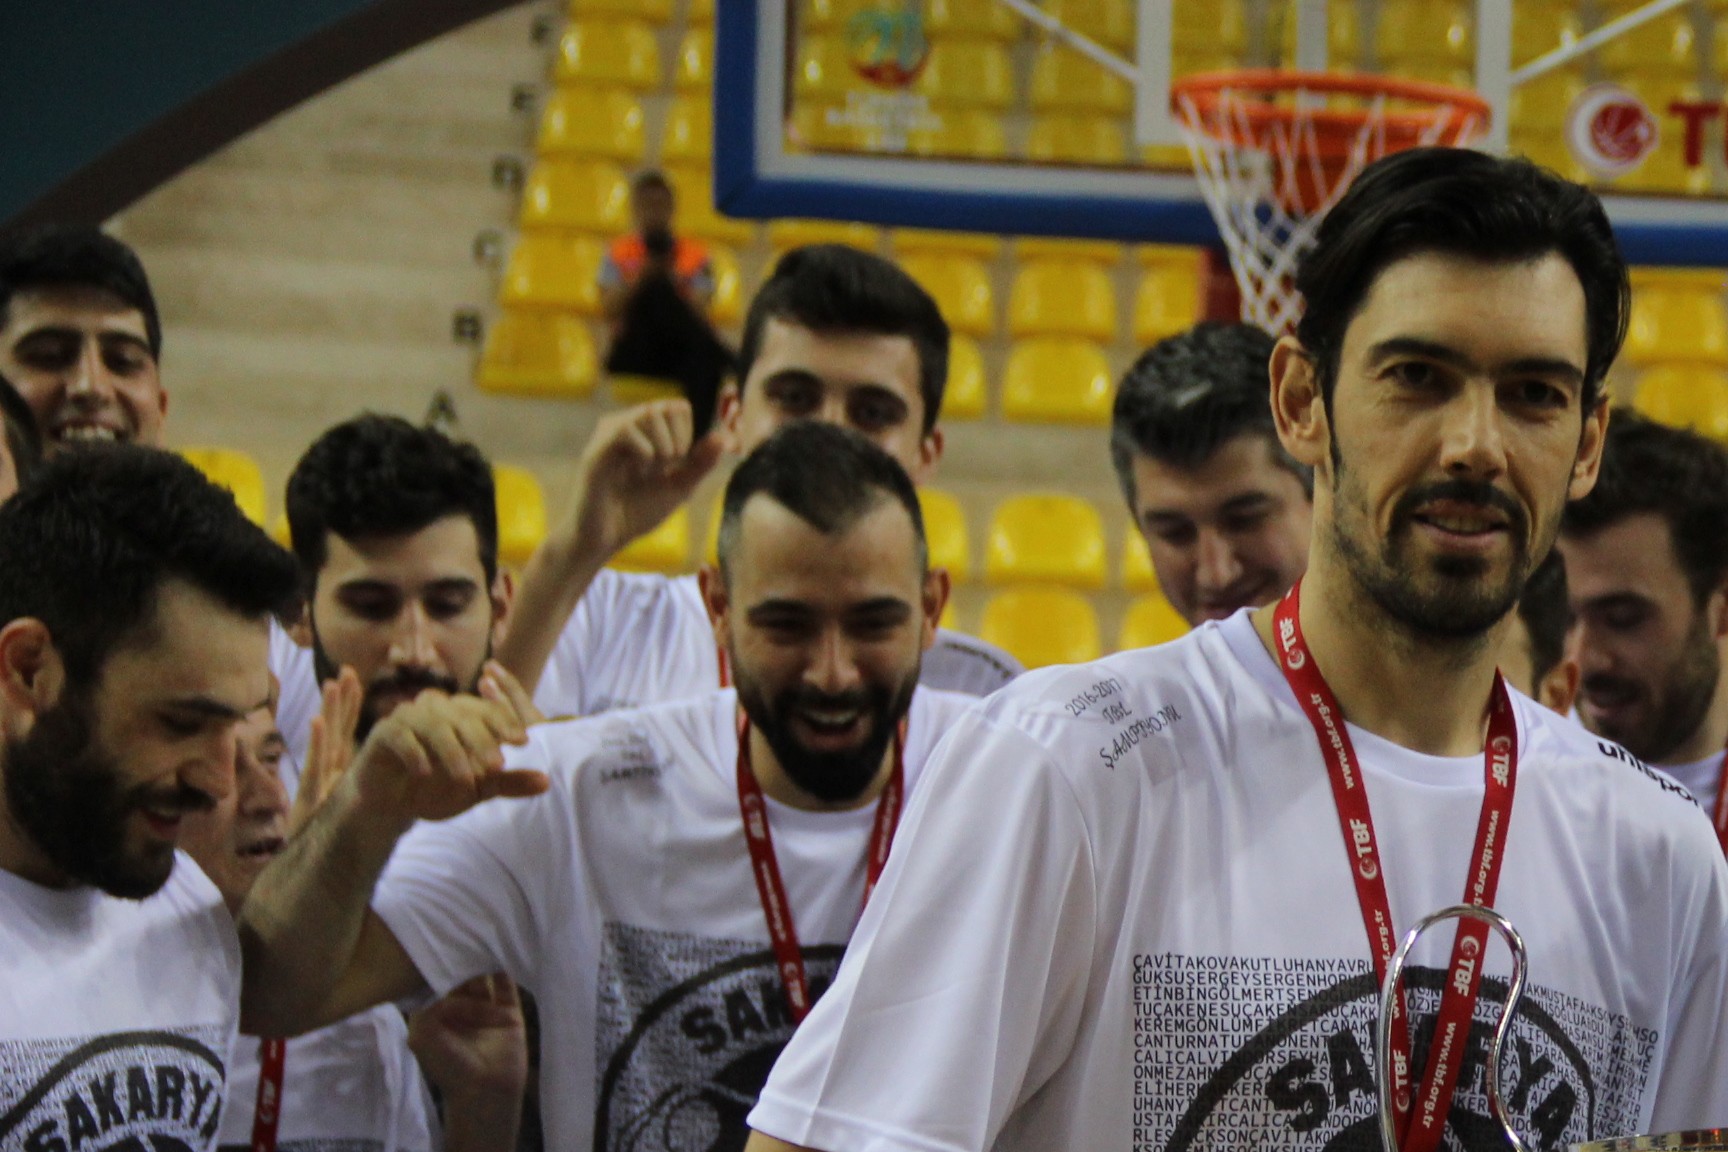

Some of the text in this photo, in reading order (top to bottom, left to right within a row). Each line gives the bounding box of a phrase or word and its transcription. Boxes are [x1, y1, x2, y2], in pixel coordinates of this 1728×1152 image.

[1279, 617, 1297, 652] TBF
[1310, 693, 1355, 790] www.tbf.org.tr
[1492, 753, 1510, 788] TBF
[1350, 818, 1373, 858] TBF
[1453, 958, 1476, 997] TBF
[1393, 1049, 1408, 1090] TBF
[1423, 1022, 1456, 1129] www.tbf.org.tr
